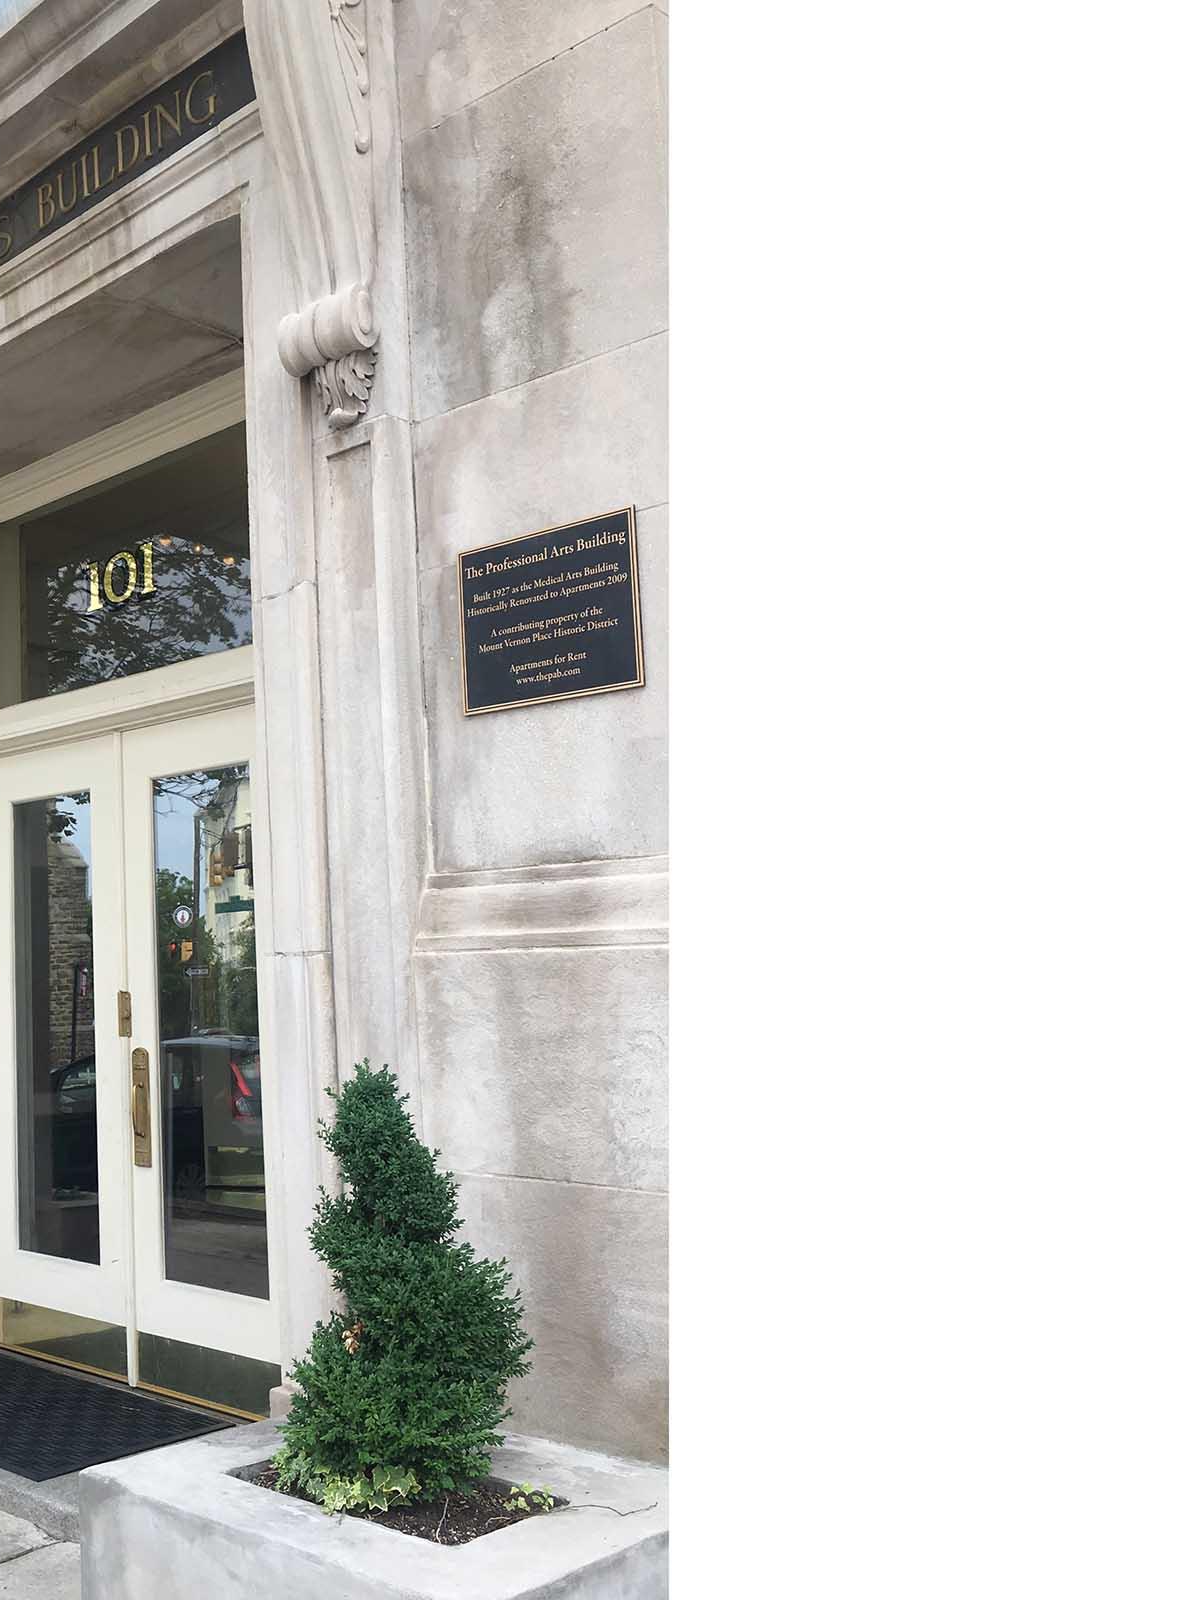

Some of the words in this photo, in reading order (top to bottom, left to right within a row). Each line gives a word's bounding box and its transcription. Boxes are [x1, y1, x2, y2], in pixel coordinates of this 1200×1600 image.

[37, 70, 217, 229] BUILDING
[464, 566, 484, 579] The
[485, 547, 548, 574] Professional
[550, 544, 574, 559] Arts
[576, 531, 626, 552] Building
[86, 542, 157, 612] 101
[467, 600, 509, 618] Historically
[510, 590, 549, 608] Renovated
[550, 590, 559, 599] to
[560, 580, 606, 598] Apartments
[607, 572, 628, 585] 2009
[473, 589, 491, 603] Built
[492, 586, 511, 599] 1927
[511, 586, 520, 594] as
[520, 581, 532, 592] the
[534, 573, 564, 589] Medical
[565, 570, 582, 581] Arts
[584, 561, 619, 576] Building
[478, 642, 503, 655] Mount
[504, 636, 531, 648] Vernon
[532, 631, 552, 643] Place
[554, 623, 586, 638] Historic
[587, 617, 619, 633] District
[490, 629, 498, 638] A
[498, 618, 545, 636] contributing
[545, 611, 579, 629] property
[580, 607, 590, 618] of
[590, 606, 604, 616] the
[509, 658, 553, 674] Apartments
[554, 654, 566, 664] for
[567, 651, 588, 662] Rent
[516, 667, 581, 686] www.thepab.com
